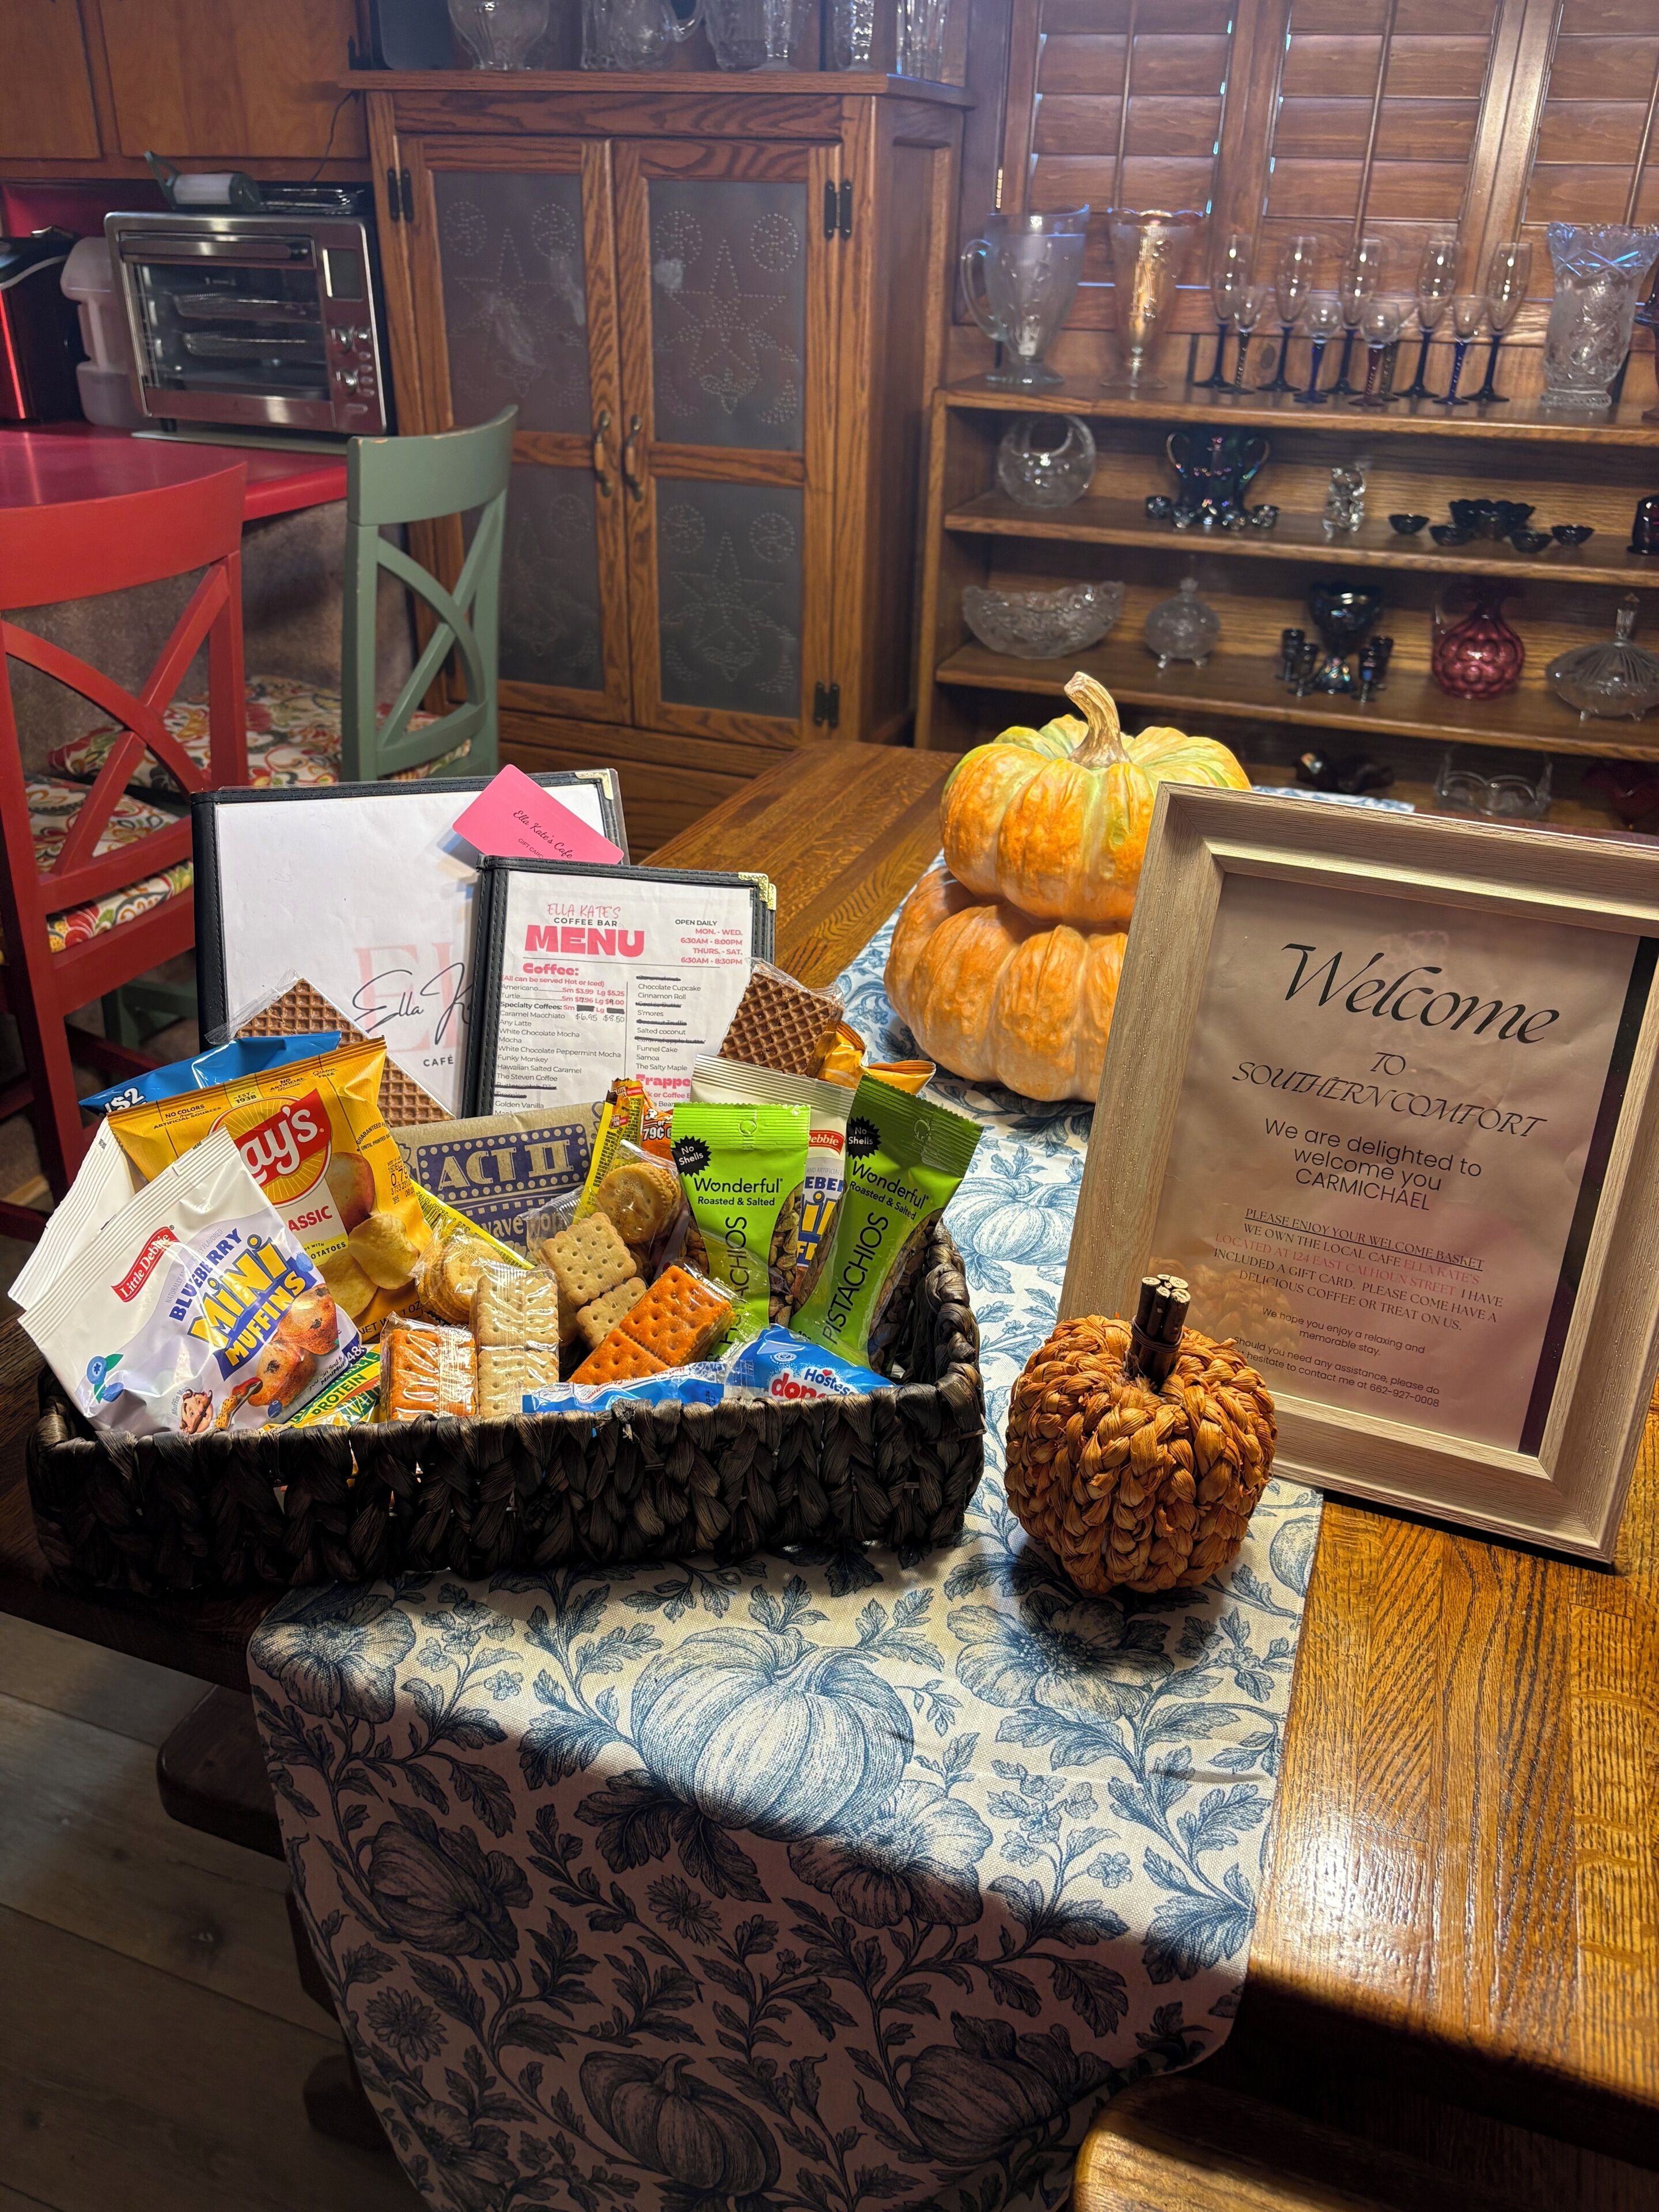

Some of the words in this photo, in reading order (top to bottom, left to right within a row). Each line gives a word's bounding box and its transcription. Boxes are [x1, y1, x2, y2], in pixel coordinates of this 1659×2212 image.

[513, 810, 528, 825] Ella
[530, 823, 554, 844] Kate's
[554, 842, 573, 859] Cafe
[518, 838, 530, 848] GIFT
[547, 903, 574, 916] ELLA
[525, 925, 645, 957] MENU
[523, 963, 579, 976] Coffee:
[501, 1002, 532, 1010] Specialty
[1282, 942, 1560, 1044] Welcome
[423, 1055, 454, 1067] CAFÉ
[521, 1055, 548, 1064] Monkey
[556, 1048, 597, 1057] Peppermint
[1370, 1052, 1406, 1076] TO
[270, 1077, 304, 1091] ARTIFICIAL
[165, 1111, 176, 1119] NO
[177, 1104, 206, 1115] COLORS
[235, 1094, 257, 1104] 1938
[1232, 1061, 1395, 1108] SOUTHERN
[1390, 1092, 1548, 1139] COMFORT
[153, 1117, 191, 1129] ARTIFICIAL
[191, 1107, 222, 1119] SOURCES
[855, 1127, 866, 1135] No
[240, 1106, 318, 1180] ay's
[356, 1123, 381, 1145] GUARANTEED
[848, 1137, 873, 1145] Shells
[1266, 1118, 1298, 1139] We
[1305, 1130, 1340, 1147] are
[1347, 1136, 1454, 1171] delighted
[1460, 1158, 1482, 1177] to
[679, 1152, 704, 1166] Shells
[681, 1146, 694, 1155] No
[438, 1147, 517, 1191] ACT
[1294, 1149, 1394, 1180] welcome
[1401, 1171, 1442, 1191] you
[694, 1177, 780, 1194] Wonderful
[852, 1161, 926, 1210] Wonderful
[1296, 1168, 1430, 1211] CARMICHAEL
[698, 1196, 734, 1205] Roasted
[747, 1198, 775, 1206] Salted
[850, 1181, 884, 1203] Roasted
[886, 1198, 894, 1207] &
[894, 1202, 916, 1221] Salted
[288, 1206, 332, 1232] ASSIC
[311, 1241, 346, 1260] OTATOES
[1245, 1208, 1290, 1226] PLEASE
[1292, 1218, 1330, 1235] ENJOY
[1332, 1228, 1365, 1243] YOUR
[1369, 1236, 1434, 1258] WELCOME
[1435, 1251, 1484, 1269] BASKET
[1244, 1223, 1262, 1236] WE
[1264, 1229, 1294, 1243] OWN
[1297, 1236, 1321, 1250] THE
[1323, 1242, 1365, 1259] LOCAL
[1368, 1252, 1401, 1267] CAFE
[1404, 1259, 1434, 1275] ELLA
[1437, 1267, 1481, 1285] KATE'S
[119, 1271, 145, 1298] Little
[169, 1228, 242, 1321] BLUEBERRY
[822, 1211, 889, 1345] PISTACHIOS
[1214, 1248, 1275, 1271] INCLUDED
[1289, 1267, 1316, 1281] GIFT
[1319, 1273, 1355, 1289] CARD.
[1362, 1282, 1407, 1301] PLEASE
[1410, 1294, 1449, 1311] COME
[1451, 1303, 1488, 1320] HAVE
[1215, 1233, 1272, 1254] LOCATED
[1313, 1255, 1344, 1270] EAST
[1346, 1264, 1408, 1285] CALHOUN
[1410, 1278, 1457, 1296] STREET
[1468, 1290, 1503, 1308] HAVE
[1239, 1270, 1305, 1294] DELICIOUS
[1307, 1286, 1357, 1306] COFFEE
[1359, 1298, 1377, 1310] OR
[1380, 1302, 1419, 1320] TREAT
[1421, 1313, 1441, 1325] ON
[1443, 1317, 1462, 1331] US.
[225, 1271, 306, 1366] MUFFINS
[1263, 1307, 1277, 1317] We
[1280, 1311, 1305, 1325] hope
[1306, 1320, 1324, 1330] you
[1327, 1324, 1353, 1339] enjoy
[1364, 1332, 1403, 1350] relaxing
[1405, 1343, 1425, 1354] and
[1299, 1330, 1356, 1350] memorable
[1358, 1344, 1380, 1357] stay.
[1234, 1336, 1266, 1351] Should
[1268, 1346, 1285, 1356] you
[1287, 1351, 1312, 1363] need
[1314, 1358, 1333, 1370] any
[1335, 1363, 1388, 1383] assistance,
[1391, 1377, 1424, 1391] please
[1426, 1385, 1440, 1395] do
[1246, 1351, 1285, 1368] hesitate
[1298, 1367, 1337, 1382] contact
[1338, 1377, 1354, 1385] me
[1357, 1381, 1367, 1390] at
[1370, 1384, 1440, 1407] 662-927-0008
[311, 1374, 368, 1415] PROTEIN
